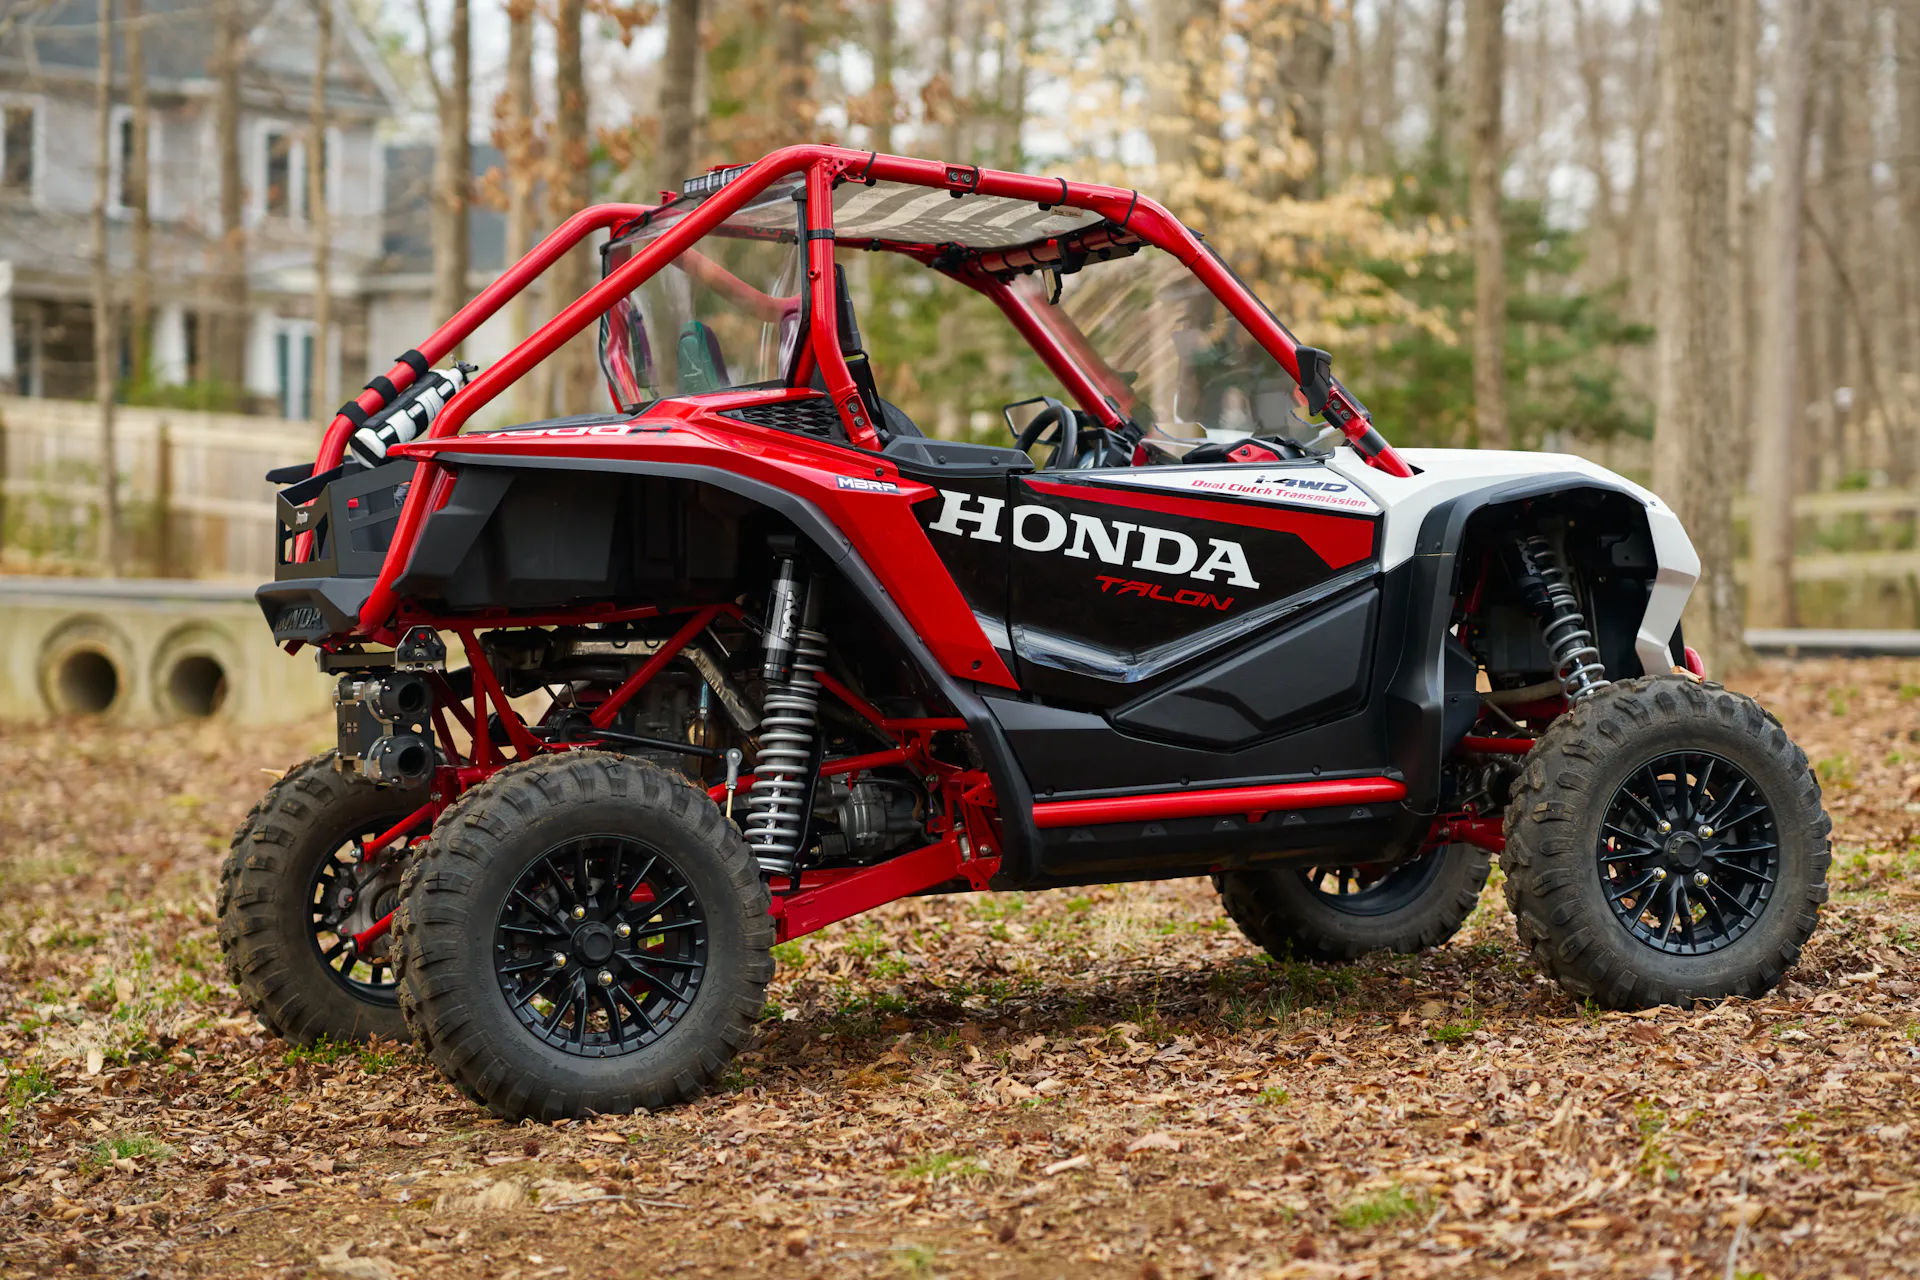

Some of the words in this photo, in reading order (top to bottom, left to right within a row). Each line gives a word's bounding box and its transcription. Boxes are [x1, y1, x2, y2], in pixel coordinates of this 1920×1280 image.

[837, 477, 897, 491] MBRP
[1191, 479, 1225, 489] Dual
[1228, 483, 1273, 496] Clutch
[1275, 489, 1367, 508] Transmission
[1254, 475, 1349, 493] i-4WD
[929, 489, 1260, 589] HONDA
[1094, 575, 1234, 611] TALON
